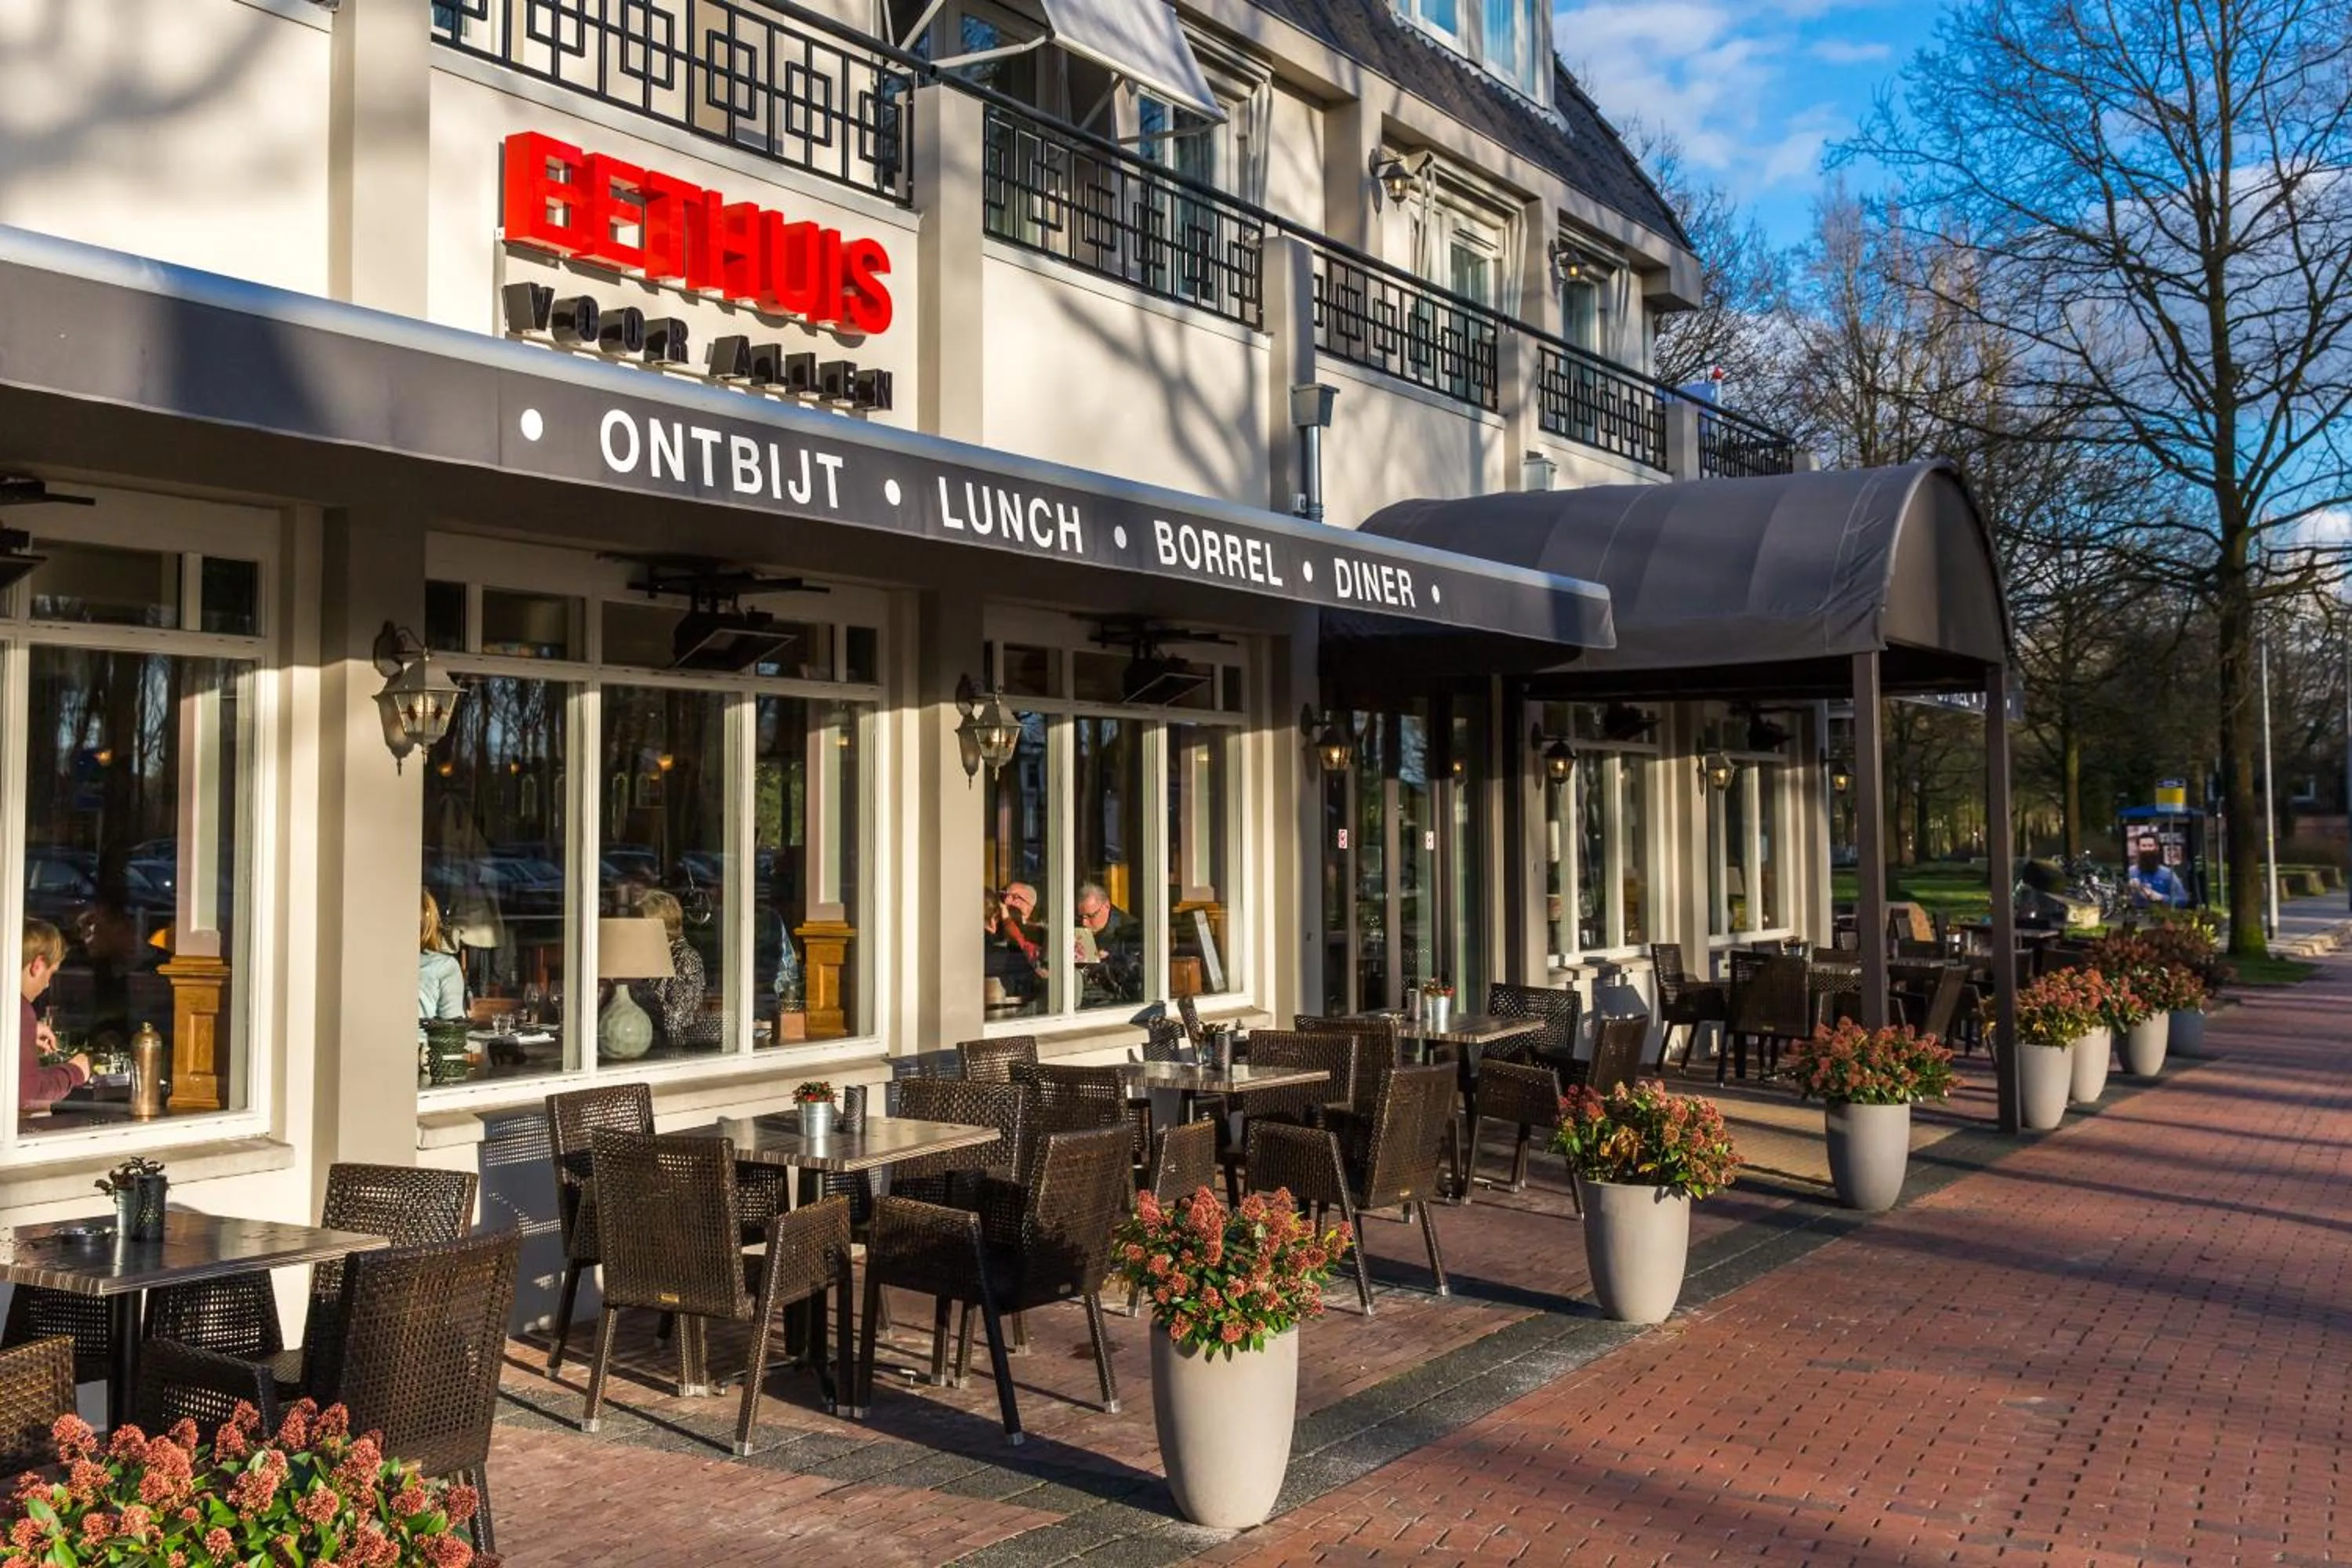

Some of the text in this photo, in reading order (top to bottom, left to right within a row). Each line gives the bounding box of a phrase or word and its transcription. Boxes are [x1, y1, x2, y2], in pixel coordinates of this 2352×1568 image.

[505, 131, 892, 334] EETHUIS
[503, 281, 892, 410] VOOR ALLEN
[600, 408, 1416, 608] ONTBIJT LUNCH BORREL DINER
